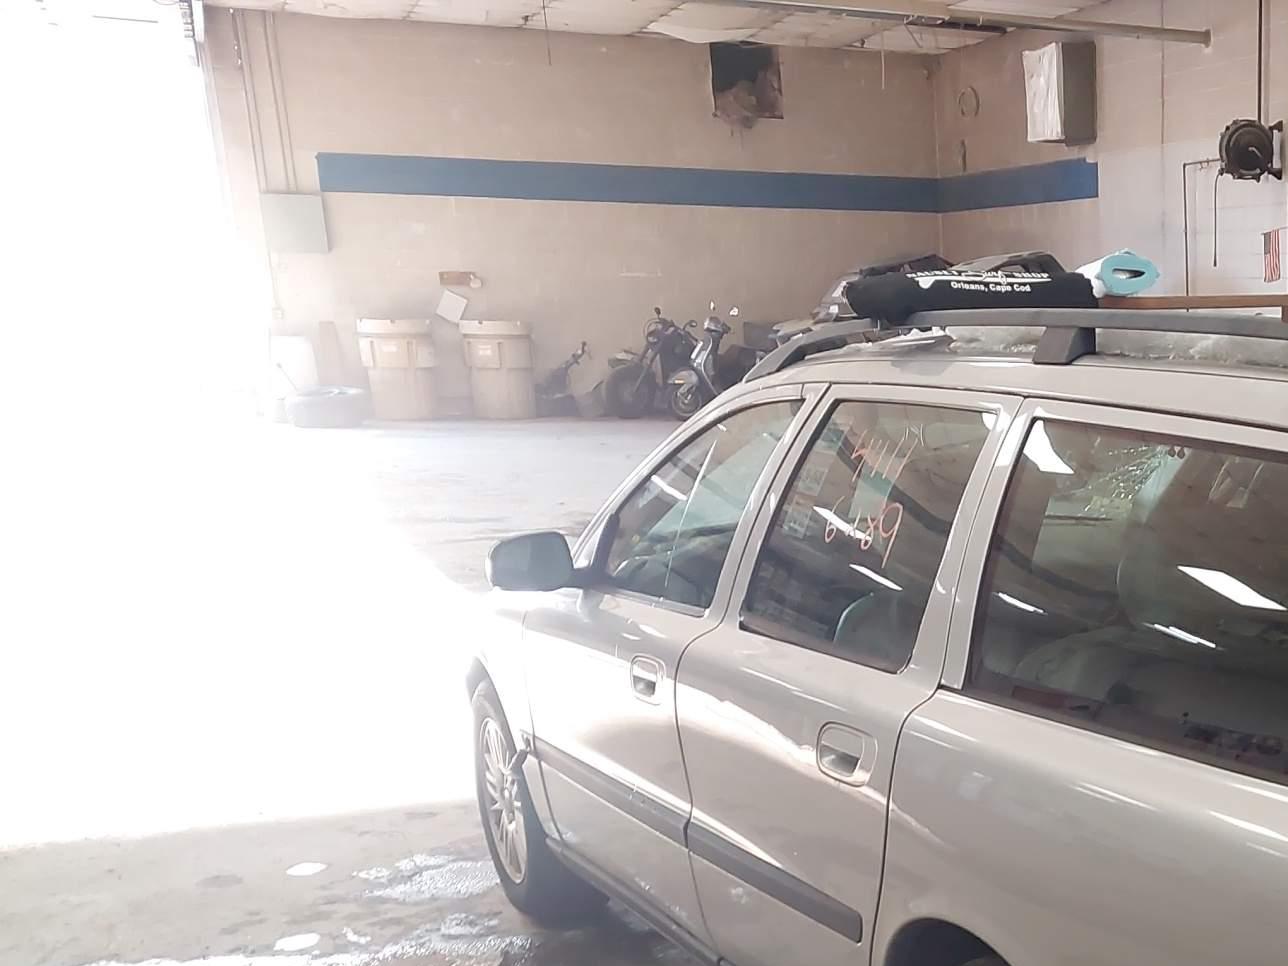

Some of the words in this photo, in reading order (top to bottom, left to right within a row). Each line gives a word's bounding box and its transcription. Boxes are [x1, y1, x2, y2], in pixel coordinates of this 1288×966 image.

[951, 281, 988, 292] Orleans,
[989, 283, 1012, 293] Cape
[1013, 283, 1031, 292] Cod
